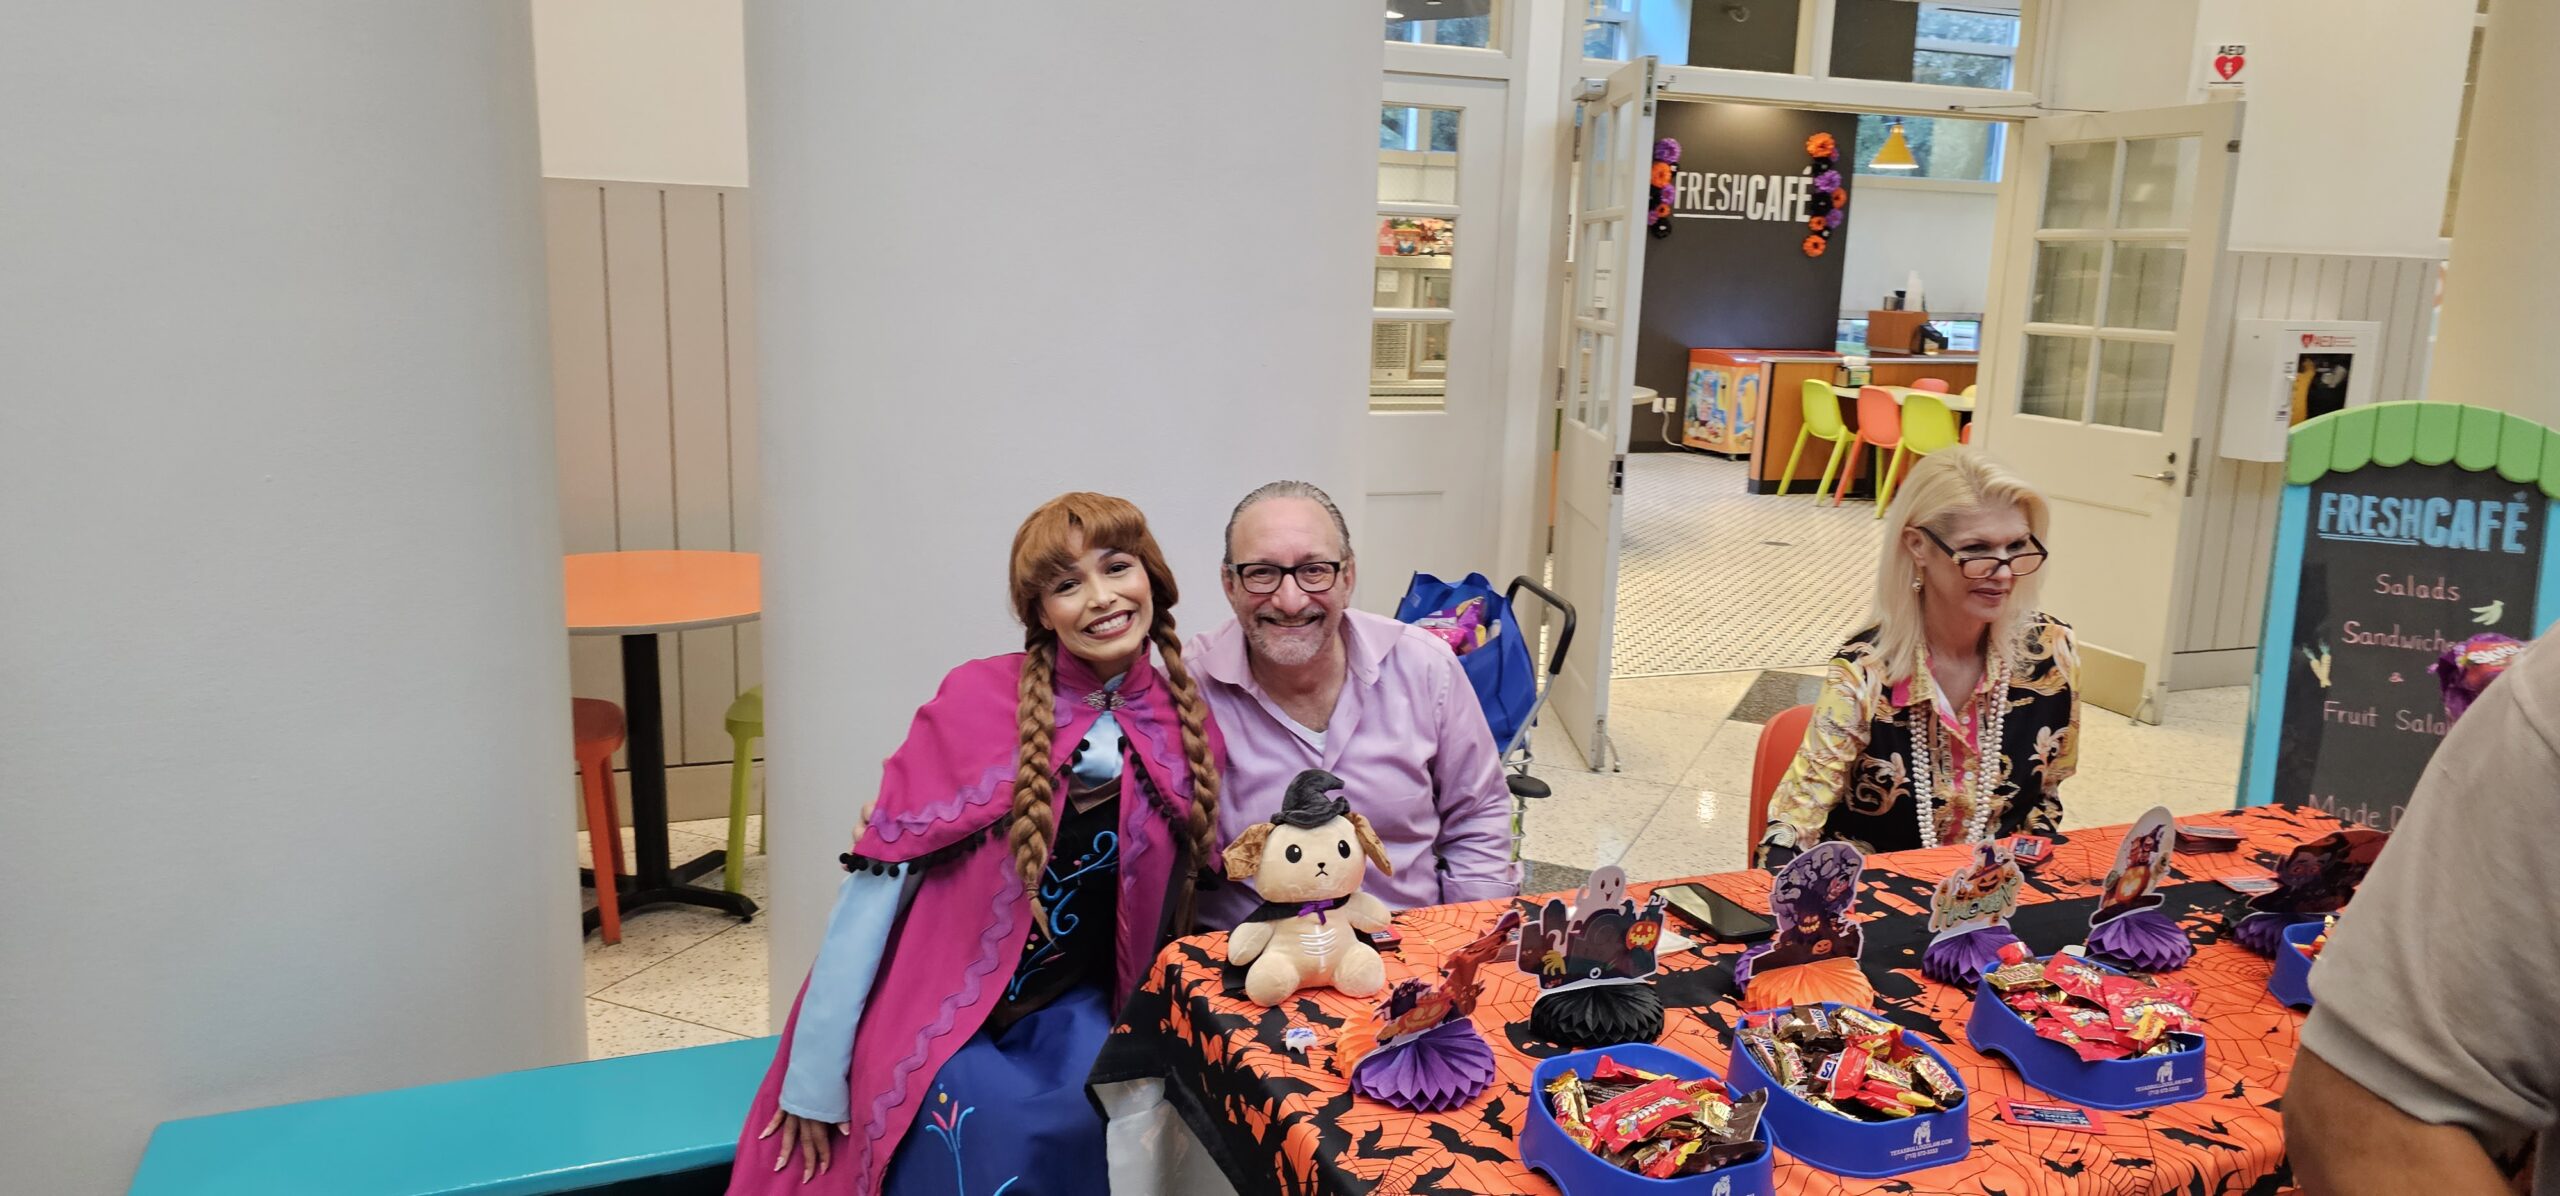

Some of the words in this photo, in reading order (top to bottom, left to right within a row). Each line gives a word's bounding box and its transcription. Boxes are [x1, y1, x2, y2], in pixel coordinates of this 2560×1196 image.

[2217, 45, 2246, 55] AED
[1673, 166, 1814, 222] FRESHCAFÉ
[2318, 491, 2530, 554] FRESHCAFÉ
[2374, 573, 2461, 601] Salads
[2342, 620, 2457, 652] Sandwiche
[2323, 700, 2379, 727] Fruit
[2395, 709, 2448, 736] Sala
